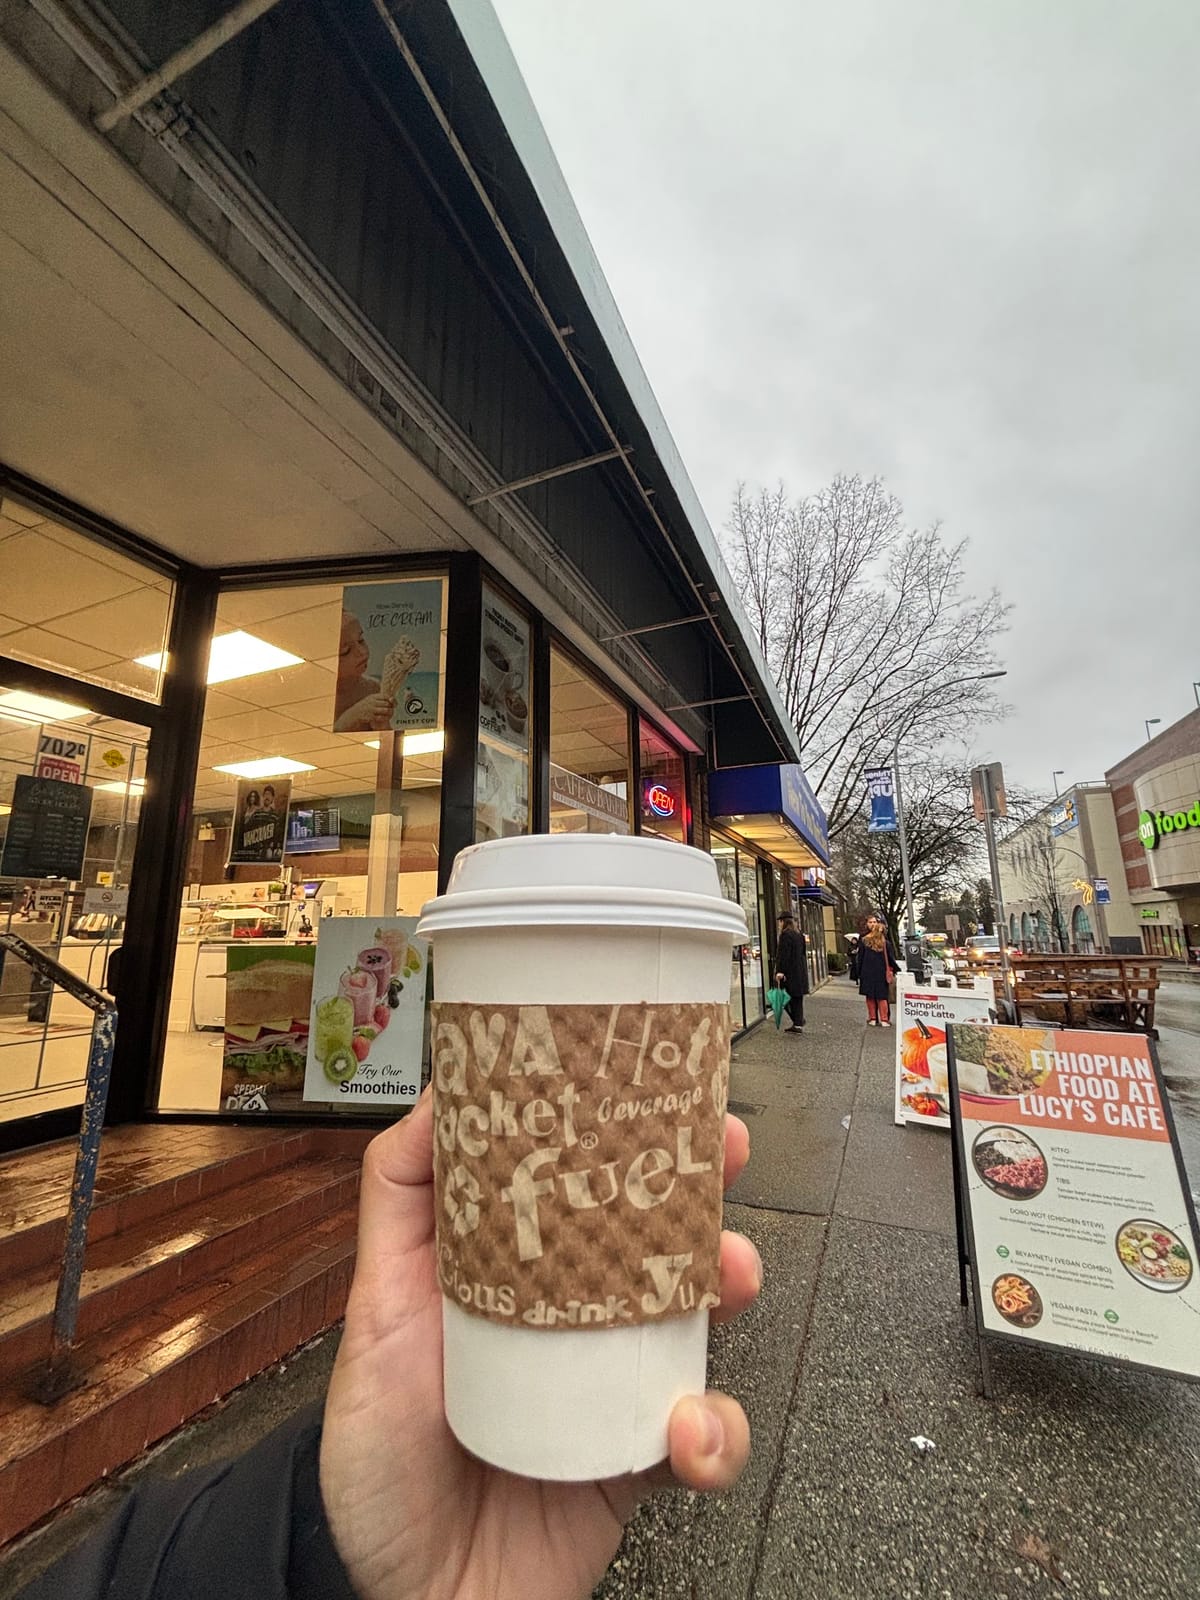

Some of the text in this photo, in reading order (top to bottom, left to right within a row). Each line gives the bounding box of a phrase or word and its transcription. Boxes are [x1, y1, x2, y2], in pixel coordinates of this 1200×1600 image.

[368, 610, 432, 628] ICE CREAM
[42, 766, 78, 784] OPEN
[651, 789, 674, 811] OPEN
[904, 1000, 945, 1011] Pumpkin
[904, 1008, 955, 1019] Spice Latte
[595, 1005, 711, 1087] Hot
[357, 1063, 402, 1080] Try Our
[1030, 1049, 1152, 1081] ETHIOPIAN
[339, 1080, 417, 1096] Smoothies
[1057, 1074, 1156, 1106] FOOD AT
[598, 1086, 703, 1123] beverage
[1018, 1093, 1165, 1131] LUCY'S CAFE
[433, 1083, 580, 1158] acket
[1009, 1207, 1028, 1216] DORO
[1030, 1210, 1045, 1219] WOT
[1047, 1213, 1080, 1224] (CHICKEN
[1054, 1257, 1080, 1267] (VEGAN
[1081, 1262, 1112, 1273] COMBO)
[522, 1295, 633, 1325] drink
[1050, 1301, 1097, 1316] VEGAN PASTA
